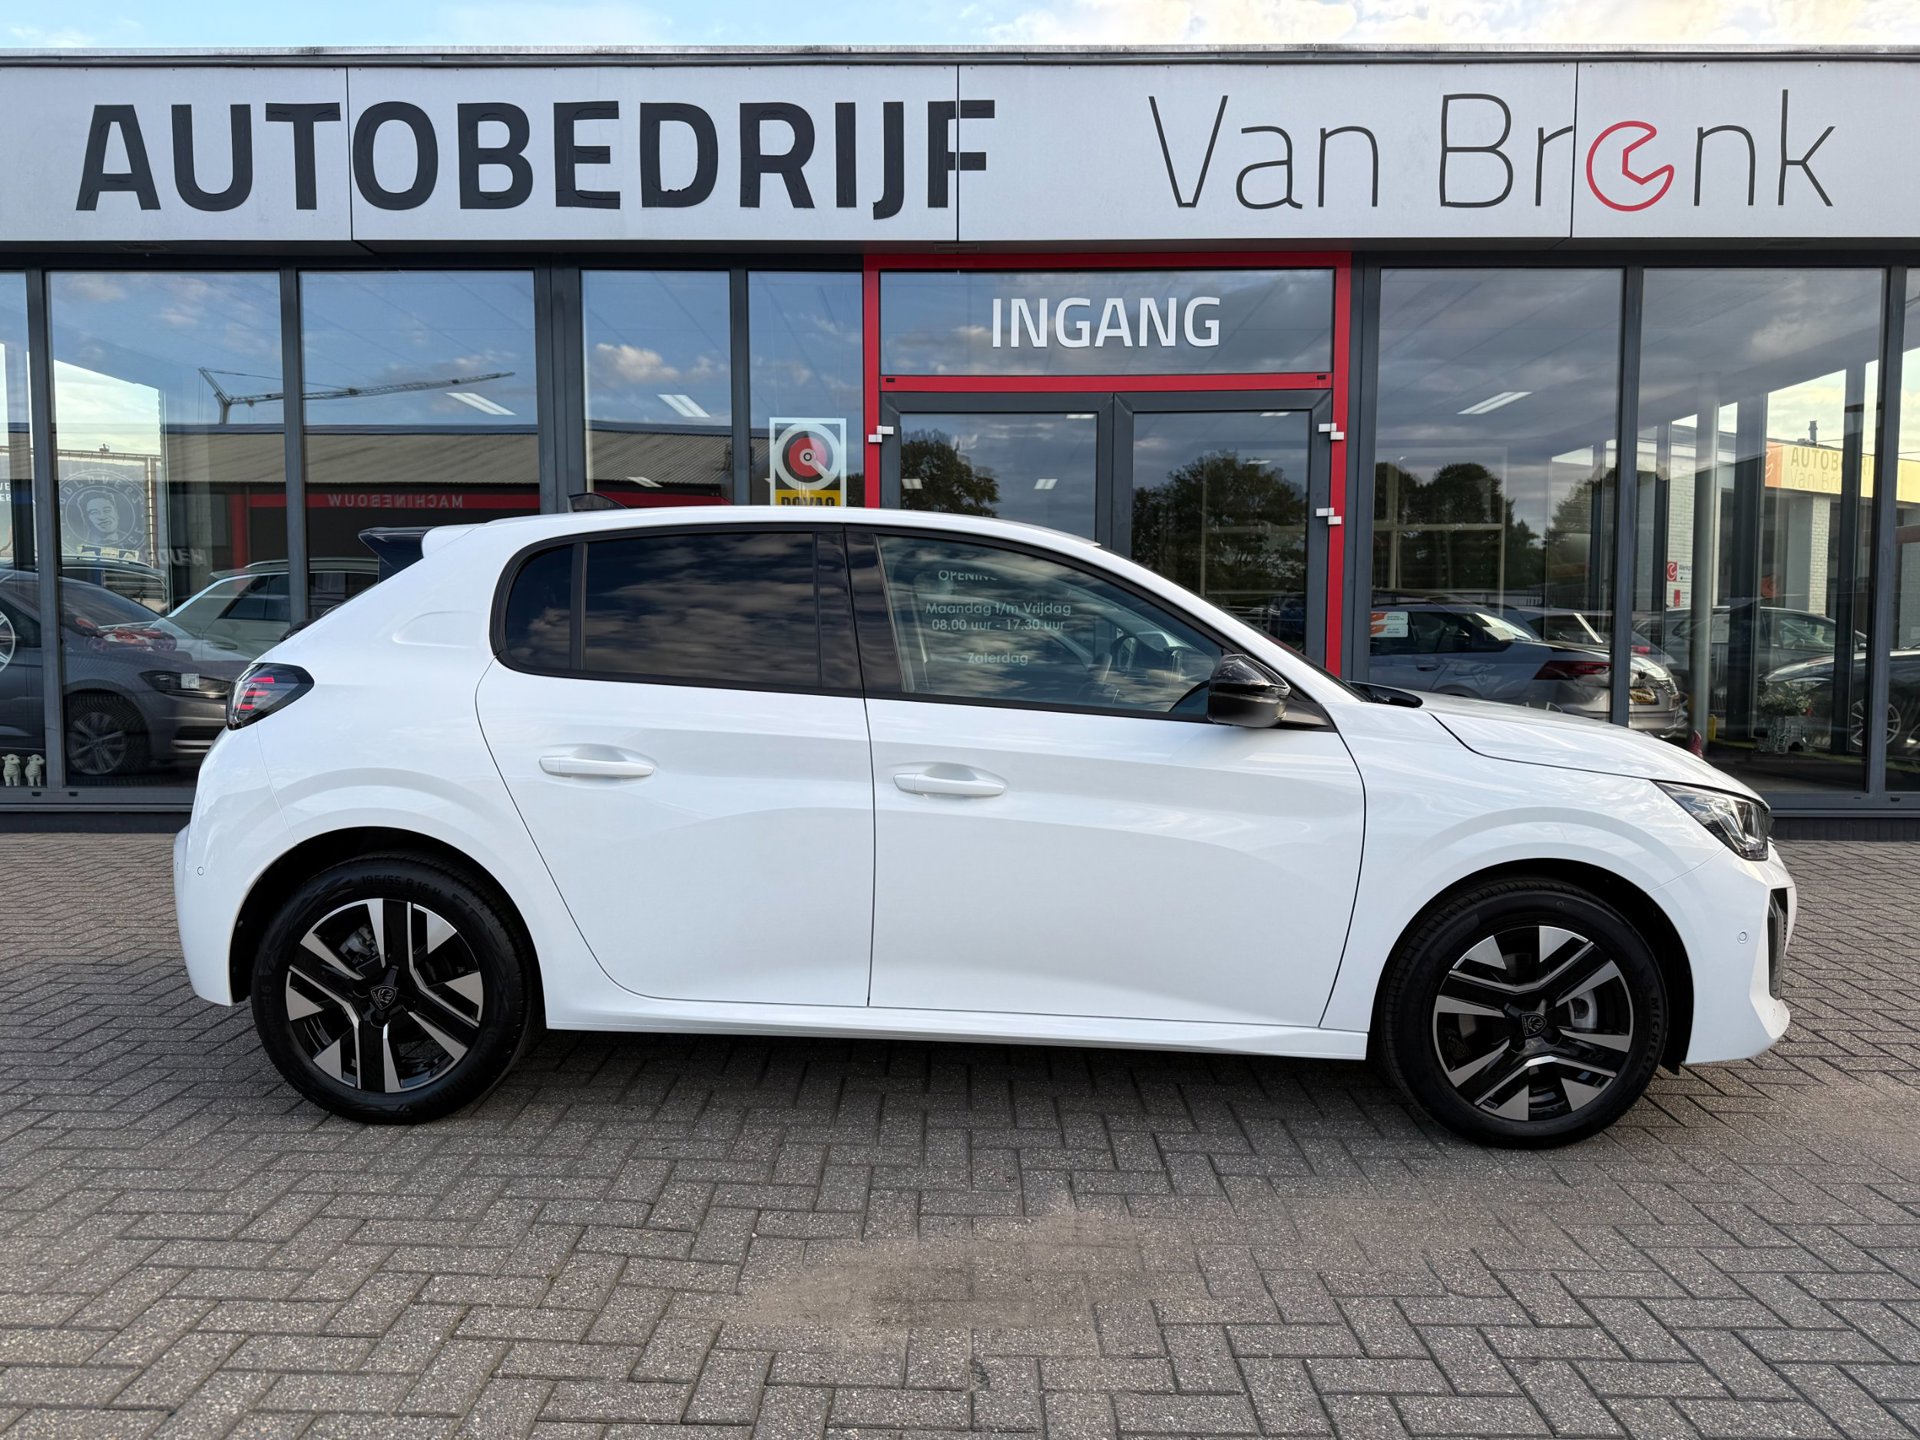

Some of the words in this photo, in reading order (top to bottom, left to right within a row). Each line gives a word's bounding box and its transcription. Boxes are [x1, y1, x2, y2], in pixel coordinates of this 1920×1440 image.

[76, 99, 995, 221] AUTOBEDRIJF
[1148, 95, 1379, 210] Van
[992, 296, 1221, 348] INGANG
[925, 602, 992, 616] Maandag
[1023, 602, 1072, 616] Vrijdag
[931, 619, 967, 631] 08.00
[971, 620, 992, 630] uur
[1006, 619, 1040, 631] 17.30
[1043, 620, 1066, 630] uur
